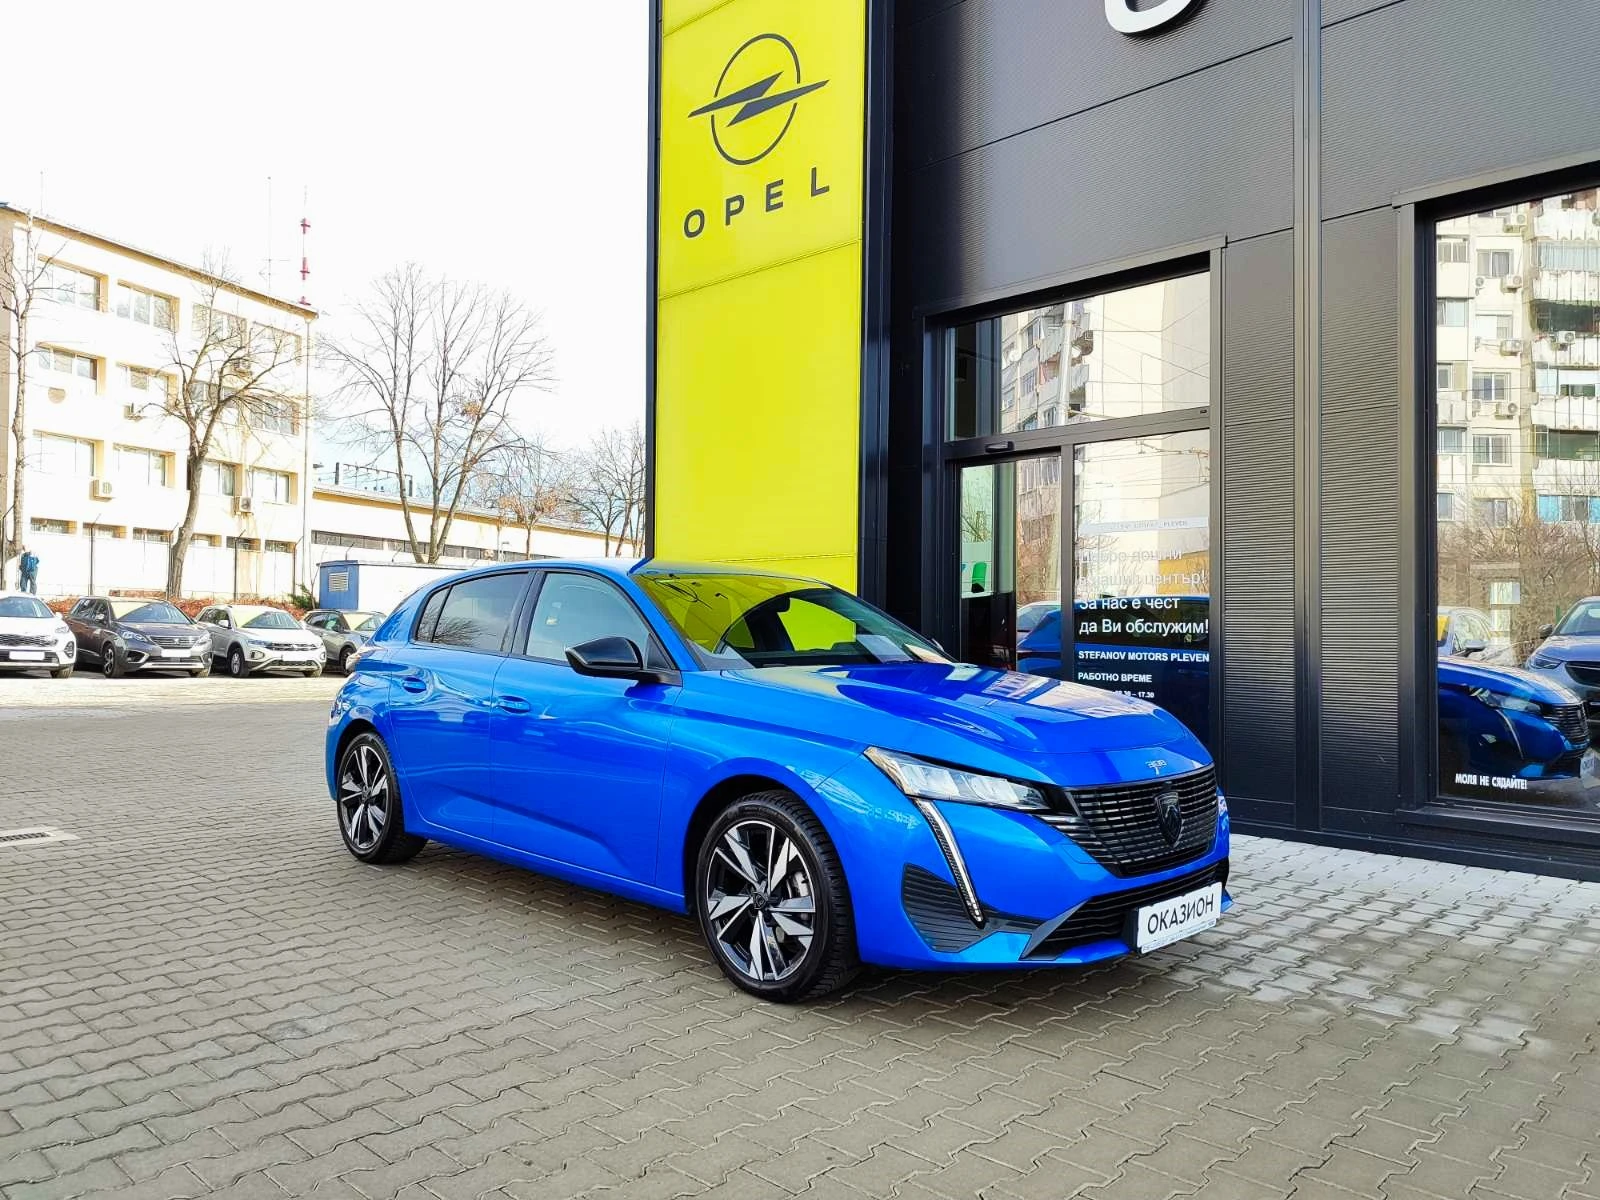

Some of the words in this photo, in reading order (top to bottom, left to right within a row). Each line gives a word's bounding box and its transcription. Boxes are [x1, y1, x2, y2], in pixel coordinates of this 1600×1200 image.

[684, 167, 830, 238] OPEL
[1080, 599, 1097, 609] За
[1101, 598, 1128, 609] нас
[1132, 598, 1141, 609] е
[1145, 598, 1180, 609] чест
[1079, 621, 1098, 634] да
[1102, 619, 1121, 632] Ви
[1125, 619, 1209, 636] обслужим!
[1078, 651, 1126, 660] STEFANOV
[1128, 652, 1168, 661] MOTORS
[1171, 653, 1210, 662] PLEVEN
[1078, 672, 1119, 681] РАБОТНО
[1121, 673, 1153, 683] ВРЕМЕ
[1455, 773, 1477, 785] МОЛЯ
[1480, 775, 1490, 787] НЕ
[1148, 894, 1213, 934] ОКАЗИОН
